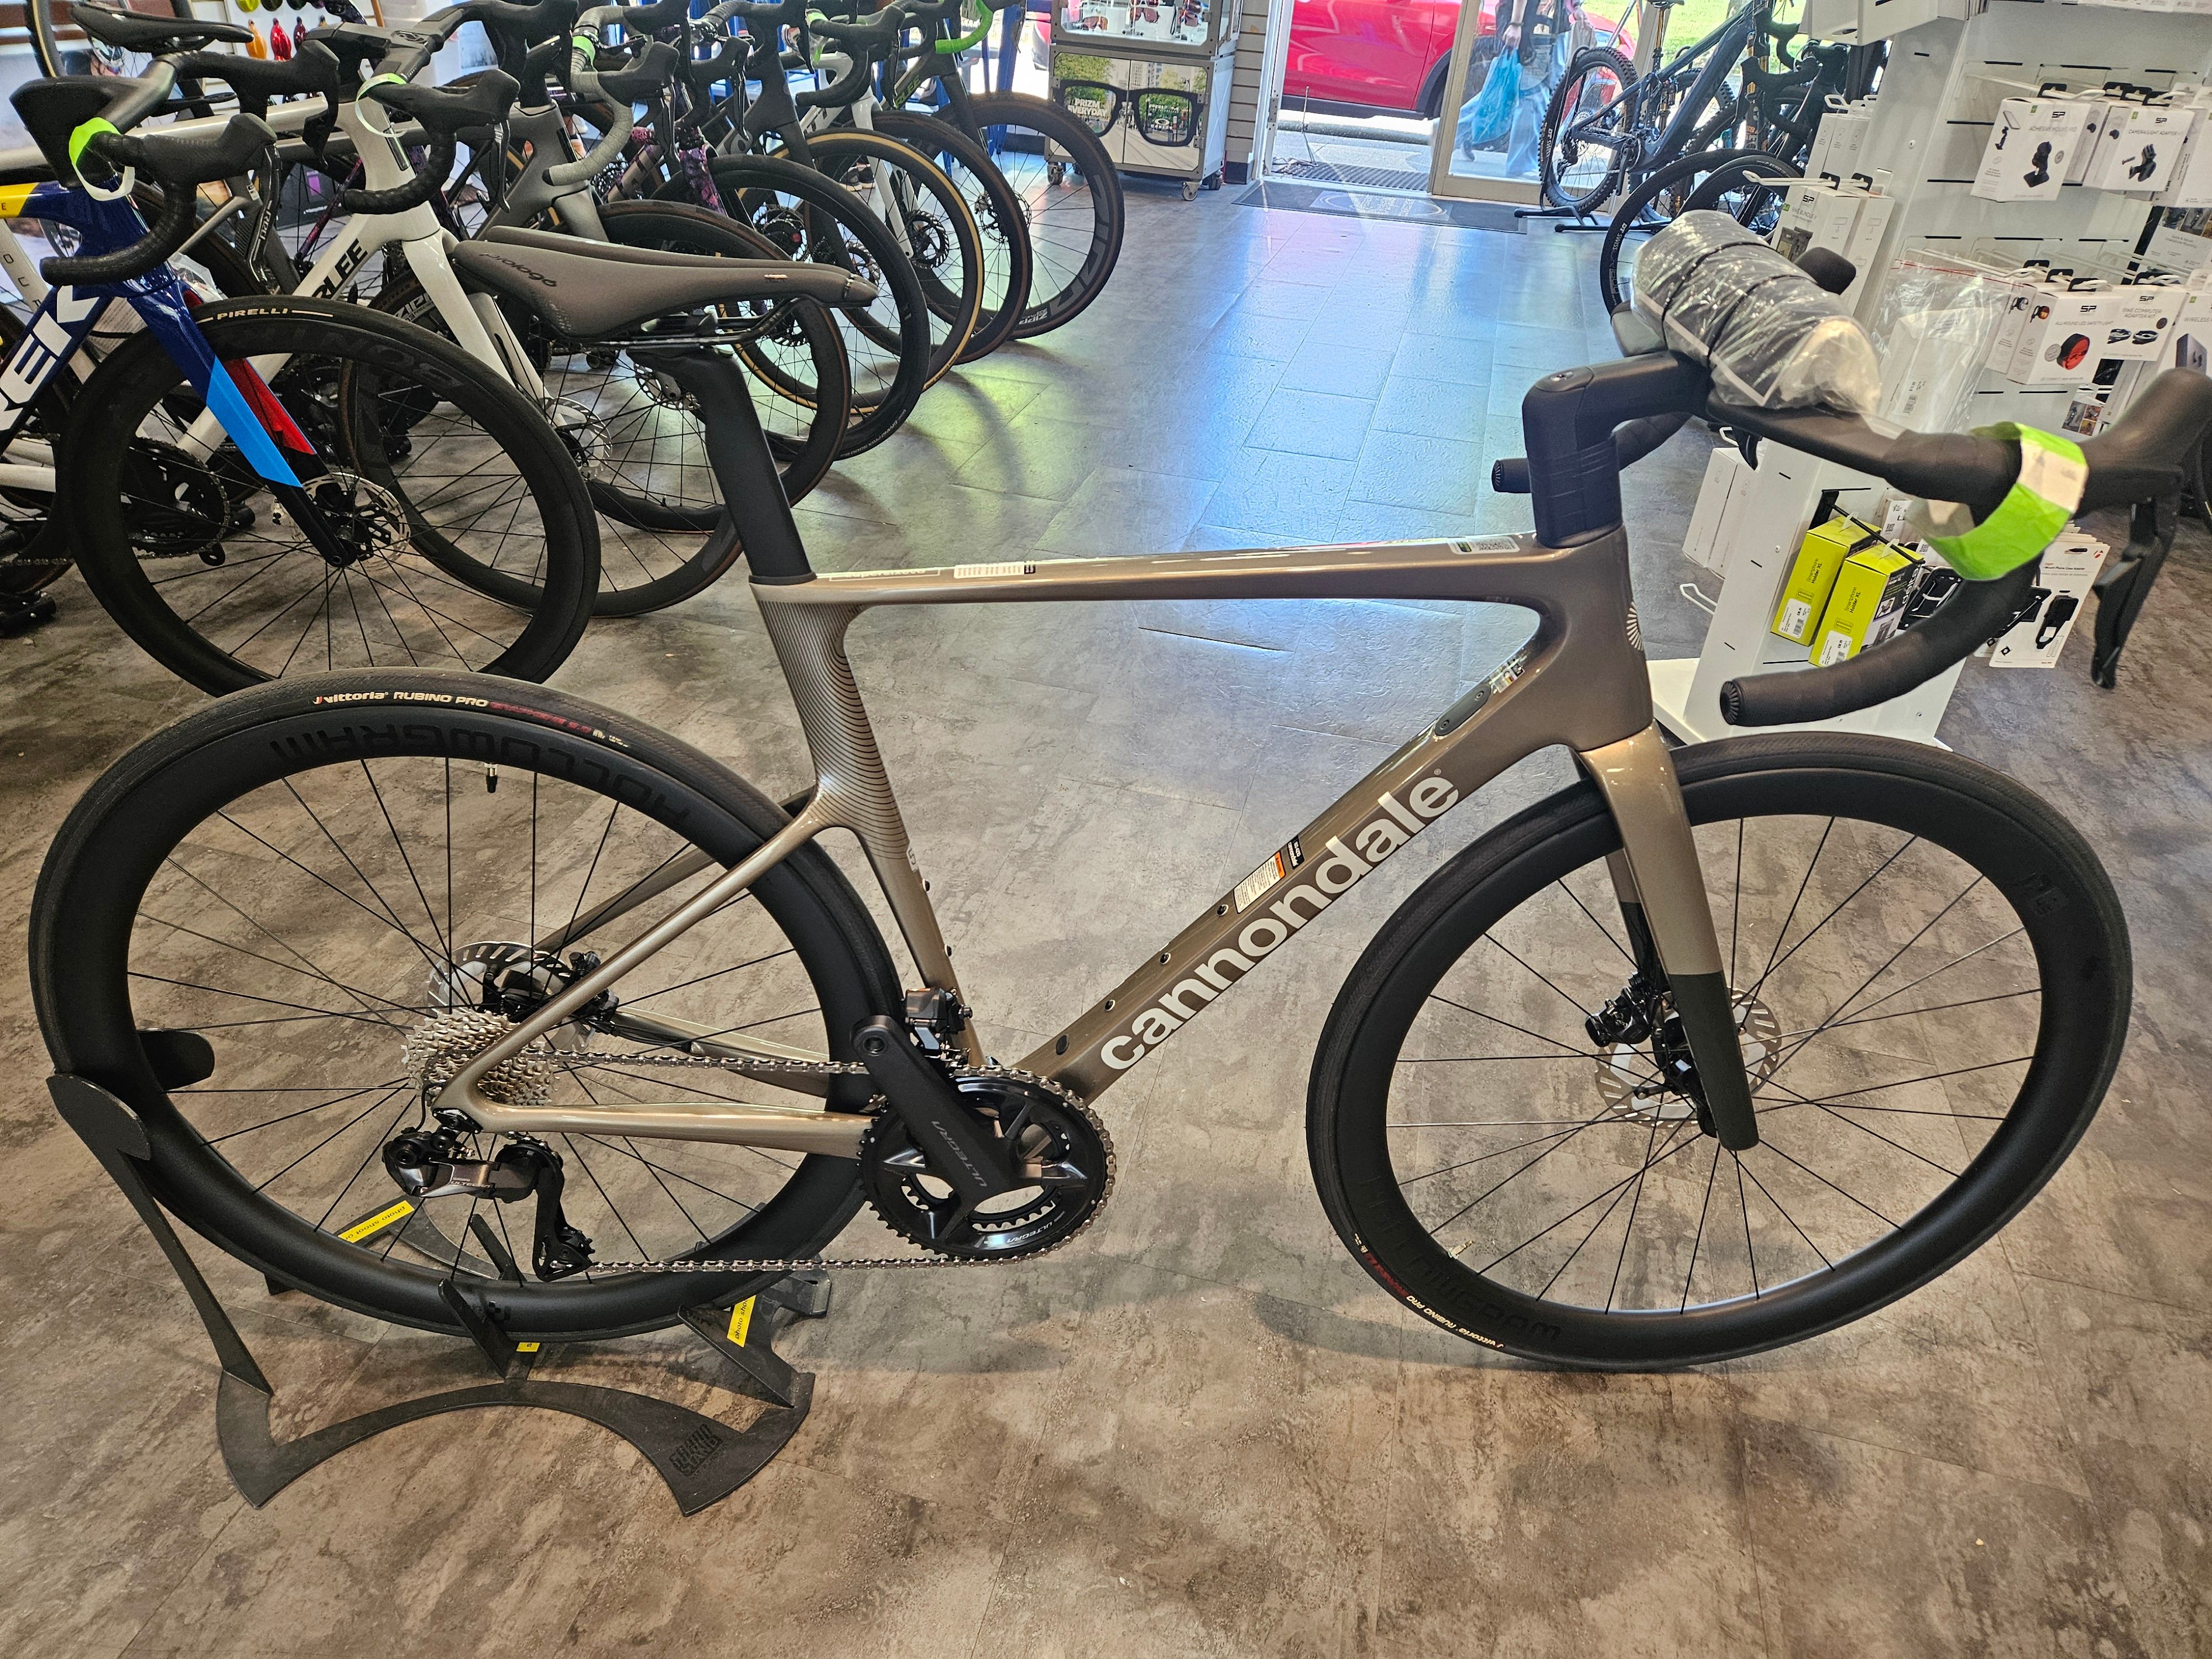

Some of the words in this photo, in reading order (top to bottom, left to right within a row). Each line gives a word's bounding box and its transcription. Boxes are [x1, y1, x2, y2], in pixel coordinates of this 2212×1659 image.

[1074, 98, 1100, 109] PRIZM
[217, 307, 288, 321] PIRELLI
[1849, 598, 1859, 613] Holder
[324, 691, 386, 704] vittoria
[393, 691, 453, 703] RUBINO
[455, 696, 489, 707] PRO
[1101, 776, 1459, 1070] cannondale
[931, 1121, 987, 1187] ULTEGRA
[382, 1206, 405, 1220] photo
[356, 1220, 380, 1235] shoot
[1406, 1295, 1425, 1310] PRO
[1423, 1308, 1457, 1329] RUBINO
